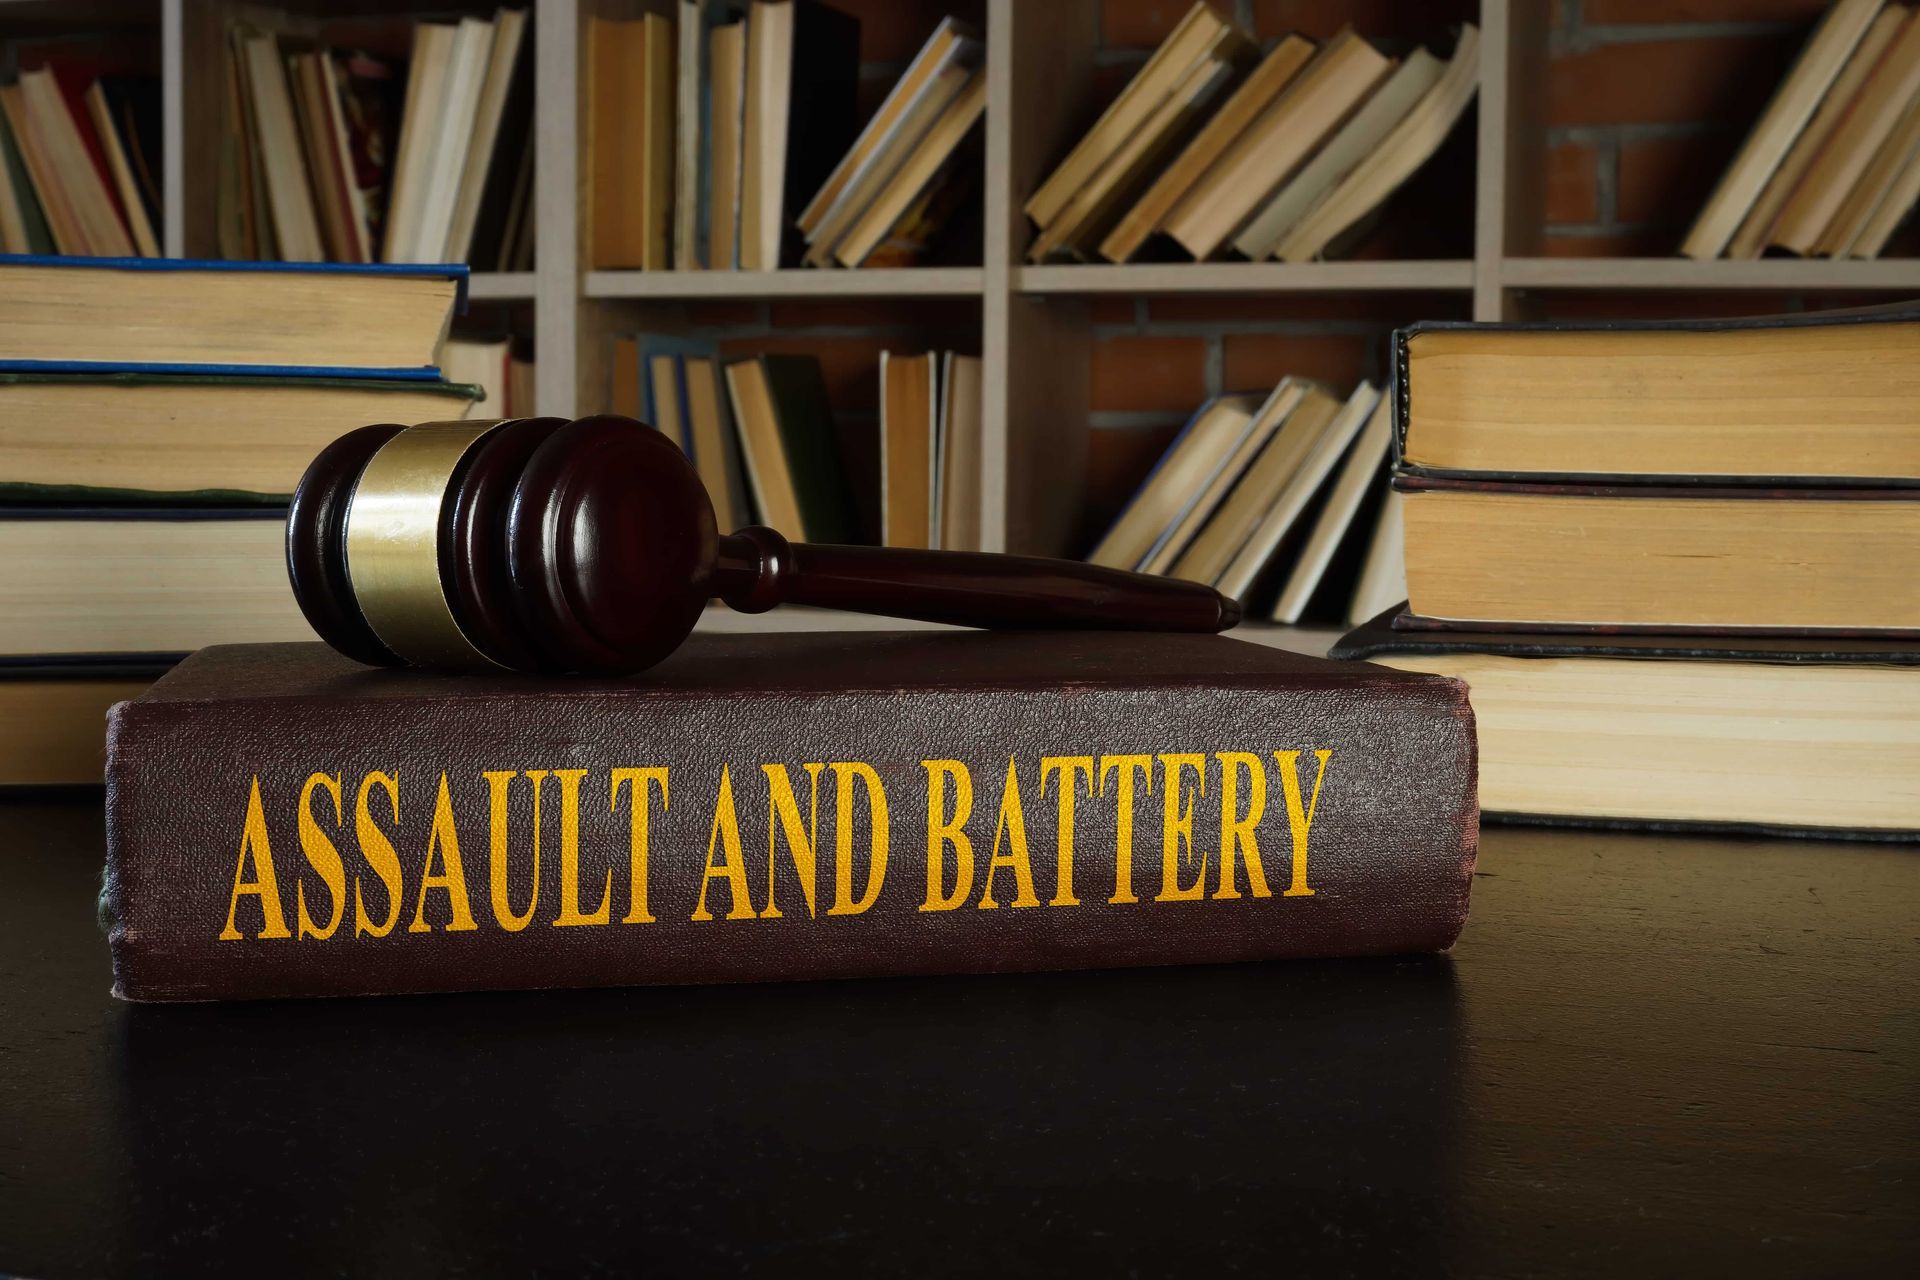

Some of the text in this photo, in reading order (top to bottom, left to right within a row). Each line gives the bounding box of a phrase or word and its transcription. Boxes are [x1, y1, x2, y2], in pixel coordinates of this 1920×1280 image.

[219, 748, 1334, 943] ASSAULT AND BATTERY
